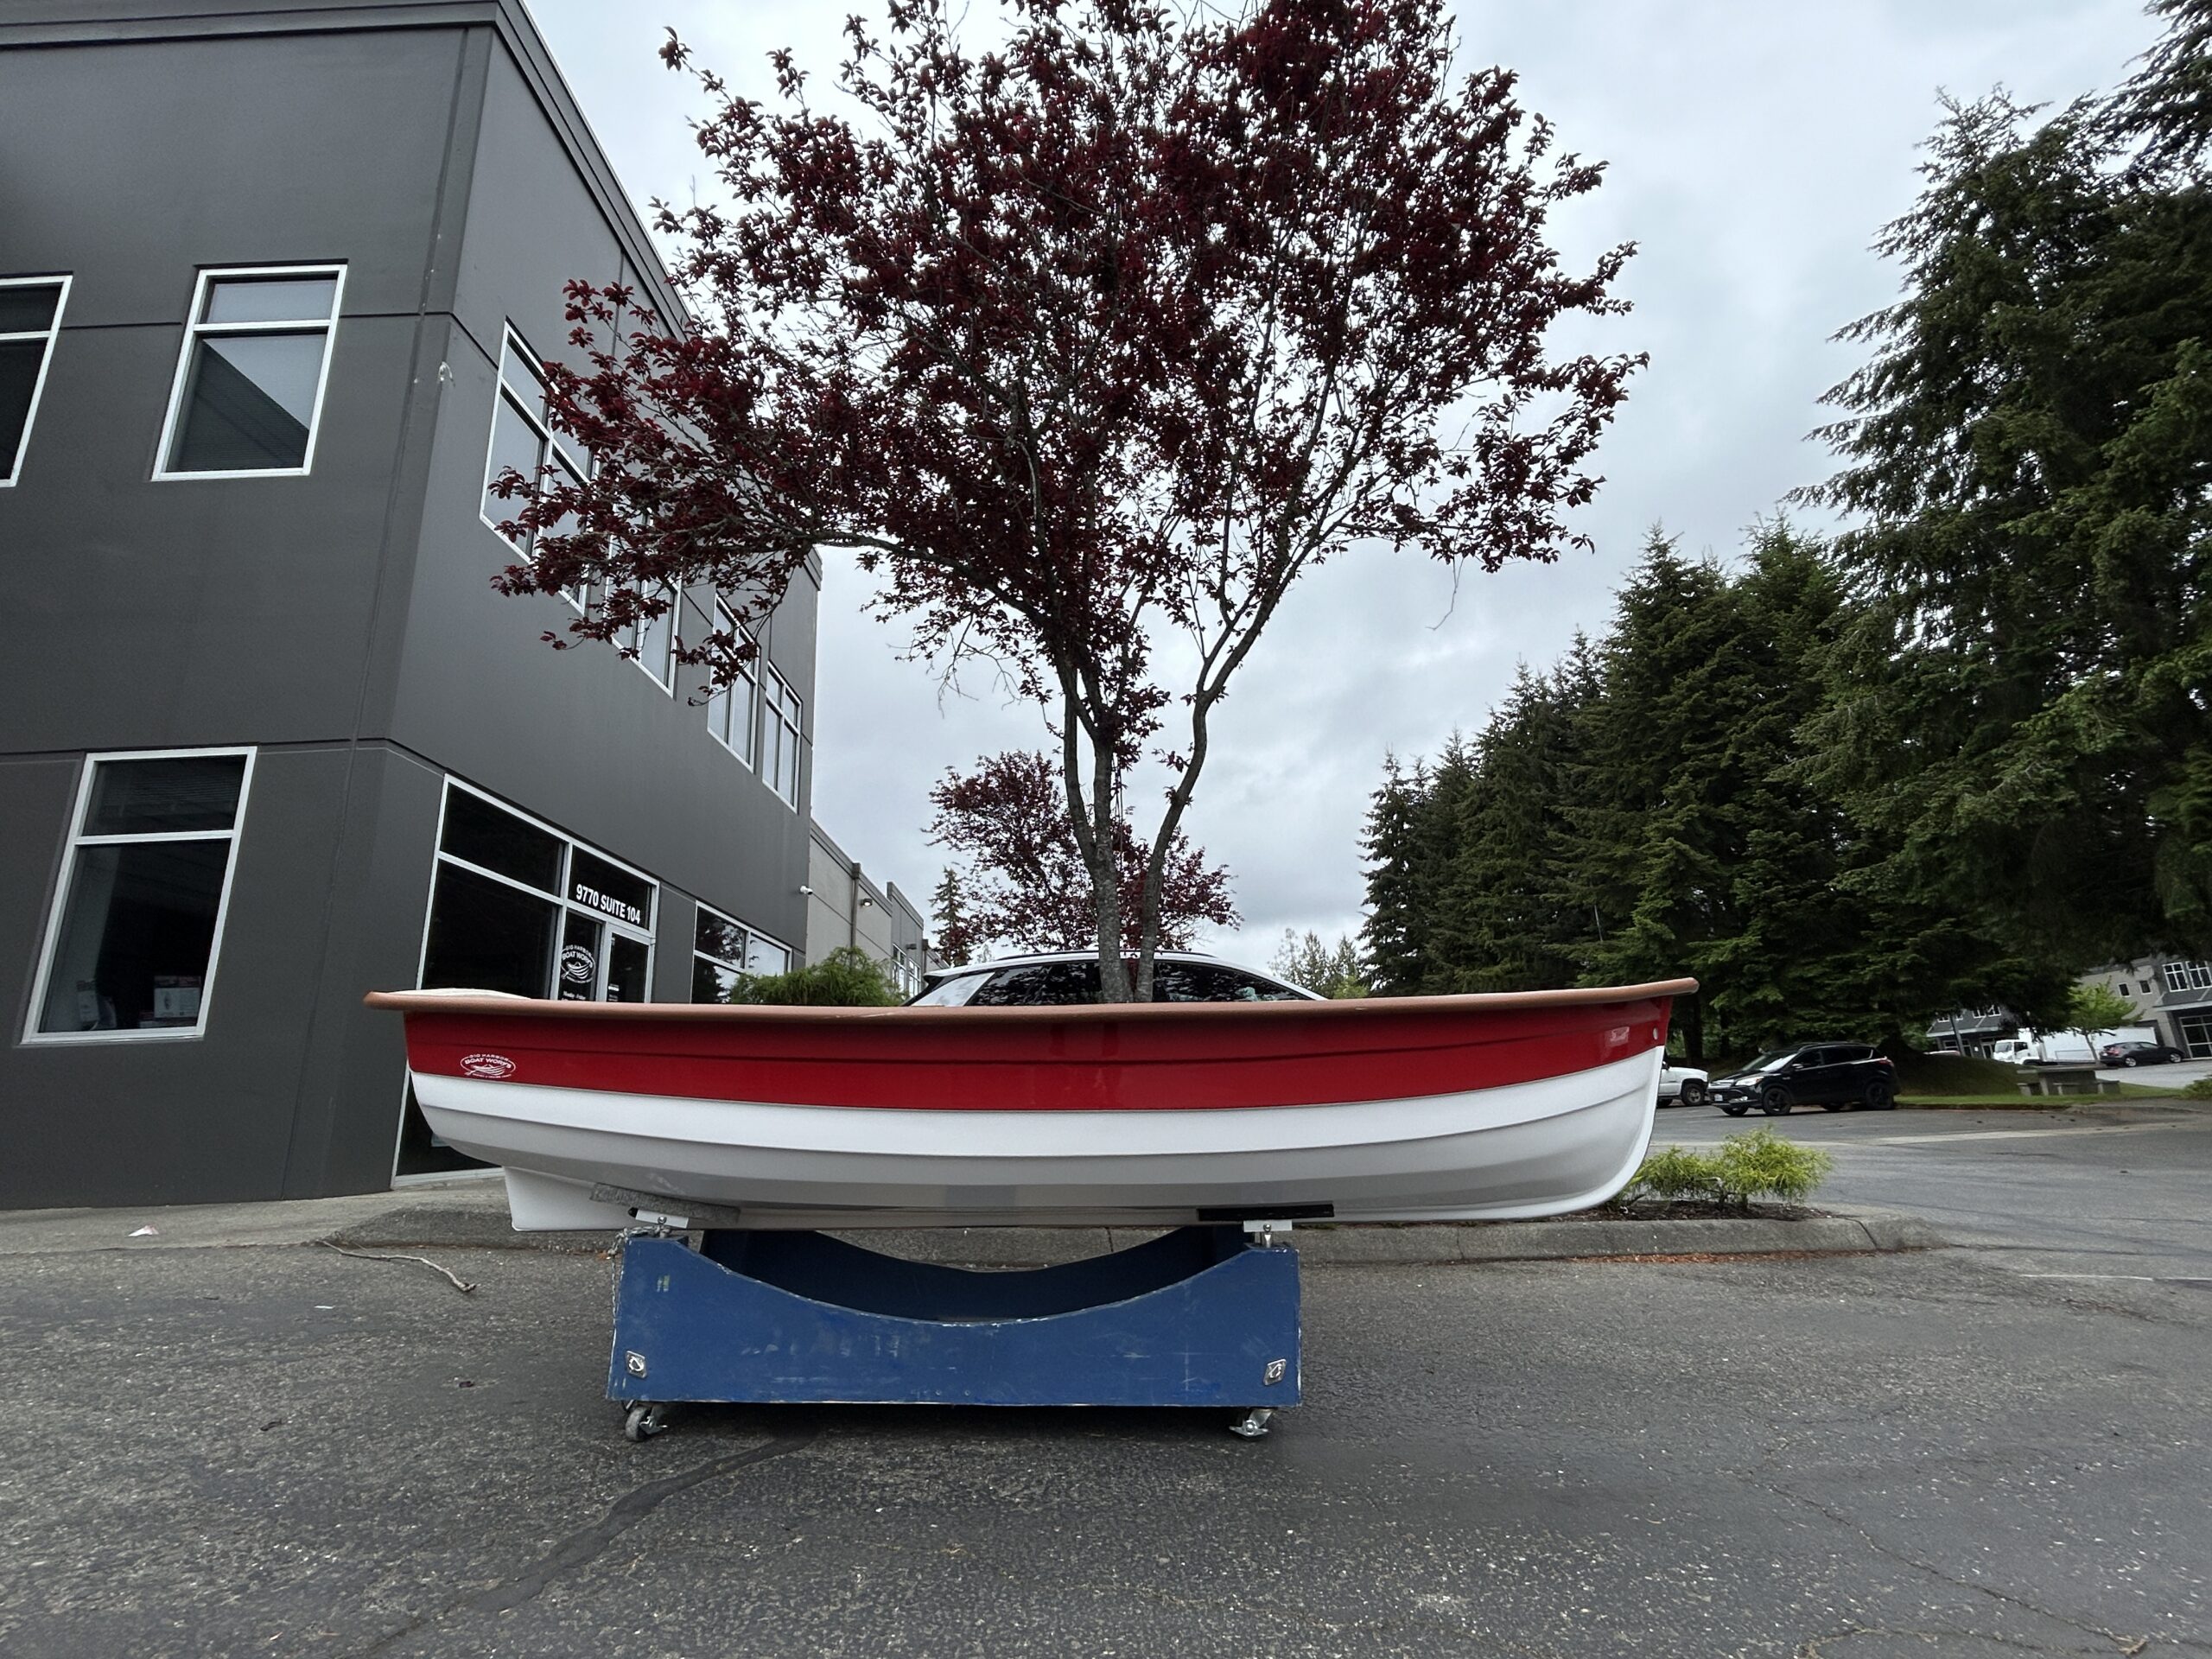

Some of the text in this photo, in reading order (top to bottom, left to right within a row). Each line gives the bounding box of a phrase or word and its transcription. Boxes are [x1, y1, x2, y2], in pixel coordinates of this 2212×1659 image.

[576, 884, 641, 925] 9770 SUITE 104
[562, 951, 575, 960] BOAT
